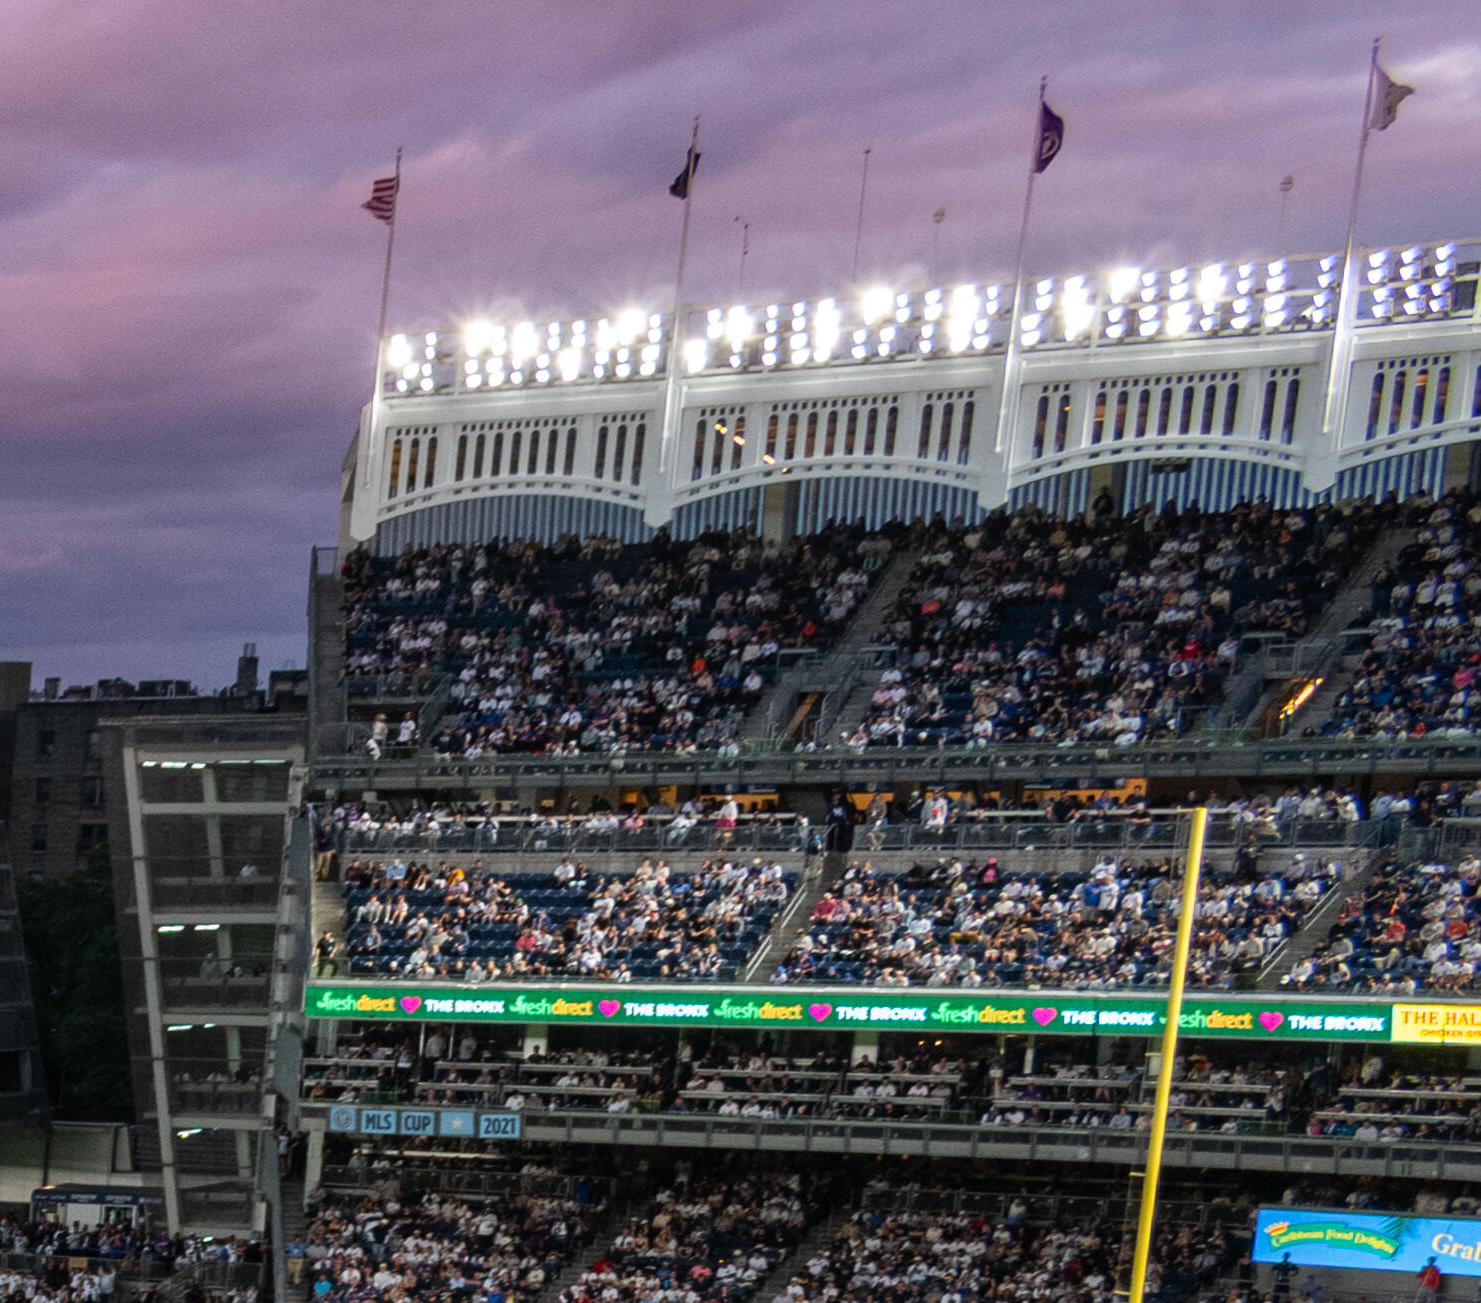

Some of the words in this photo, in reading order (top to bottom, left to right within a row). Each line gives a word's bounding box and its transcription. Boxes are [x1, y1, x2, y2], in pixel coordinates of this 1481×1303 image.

[364, 1113, 392, 1131] MLS
[403, 1115, 430, 1134] CUP
[483, 1116, 516, 1137] 2021
